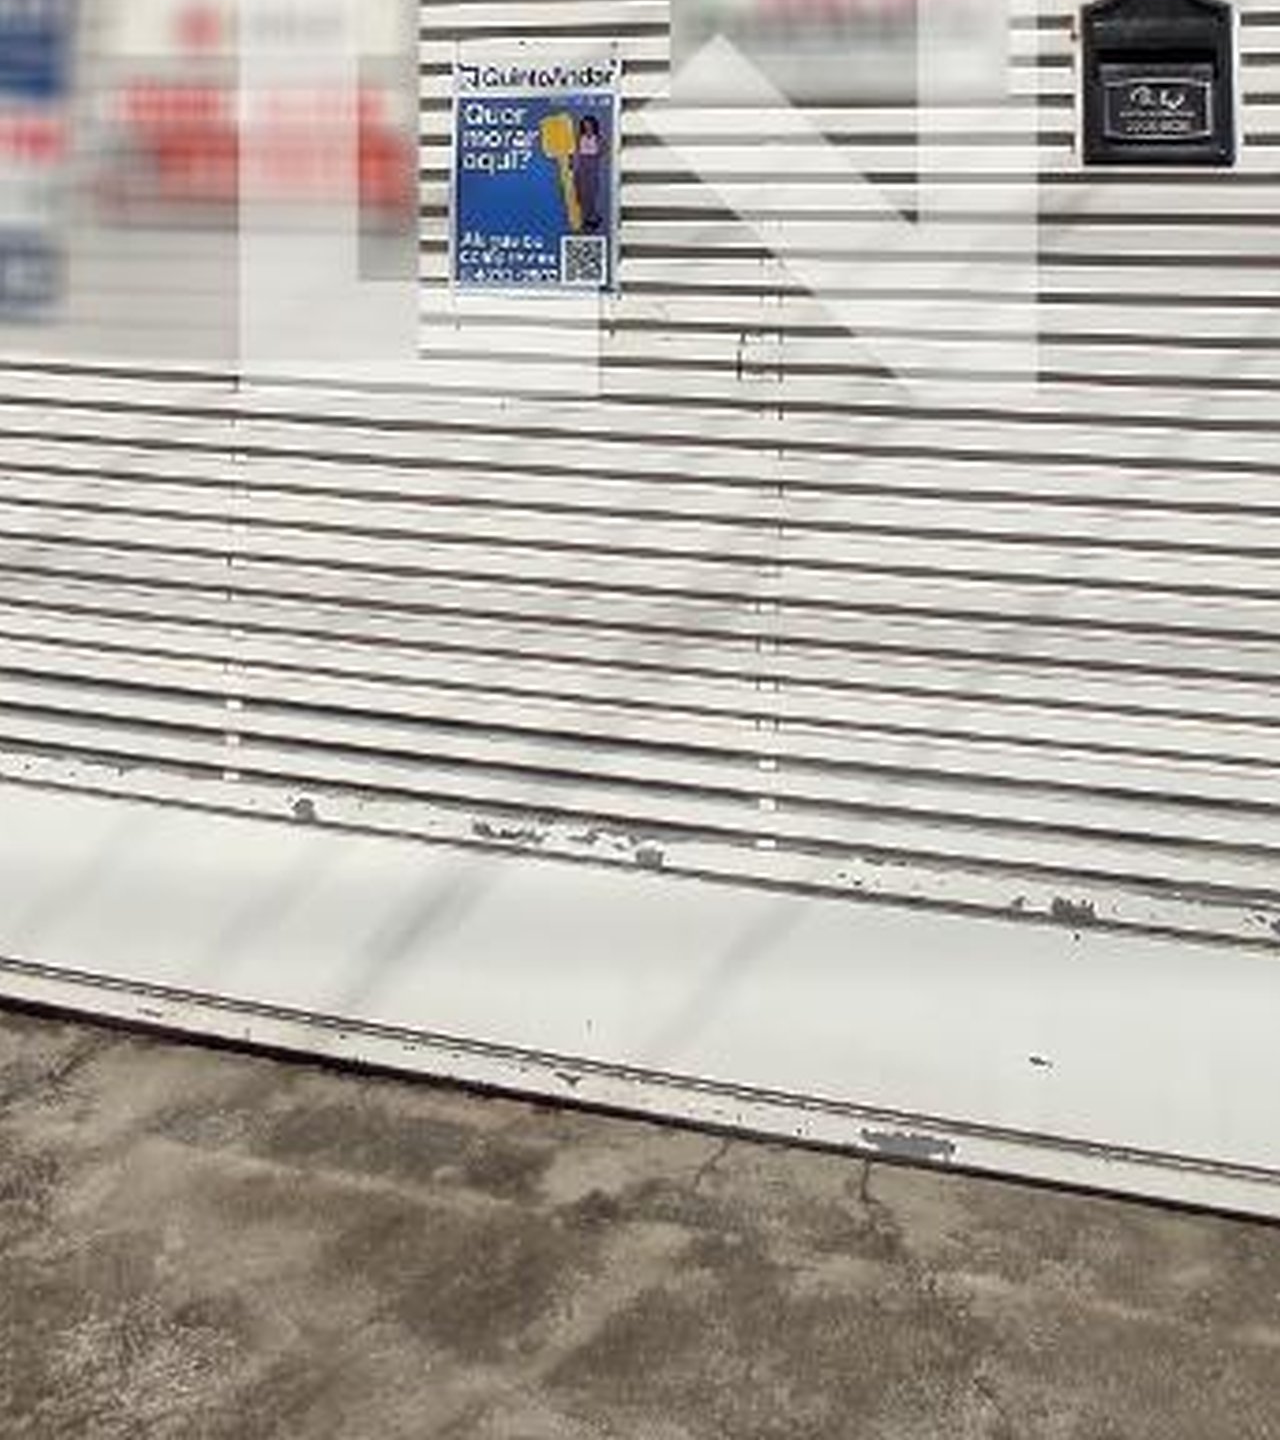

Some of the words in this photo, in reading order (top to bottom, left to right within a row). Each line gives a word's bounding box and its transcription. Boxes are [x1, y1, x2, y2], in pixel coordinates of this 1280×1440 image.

[483, 66, 614, 88] QuintoAndar
[465, 103, 527, 125] Quer
[463, 129, 539, 148] morar
[463, 151, 532, 174] aqui?
